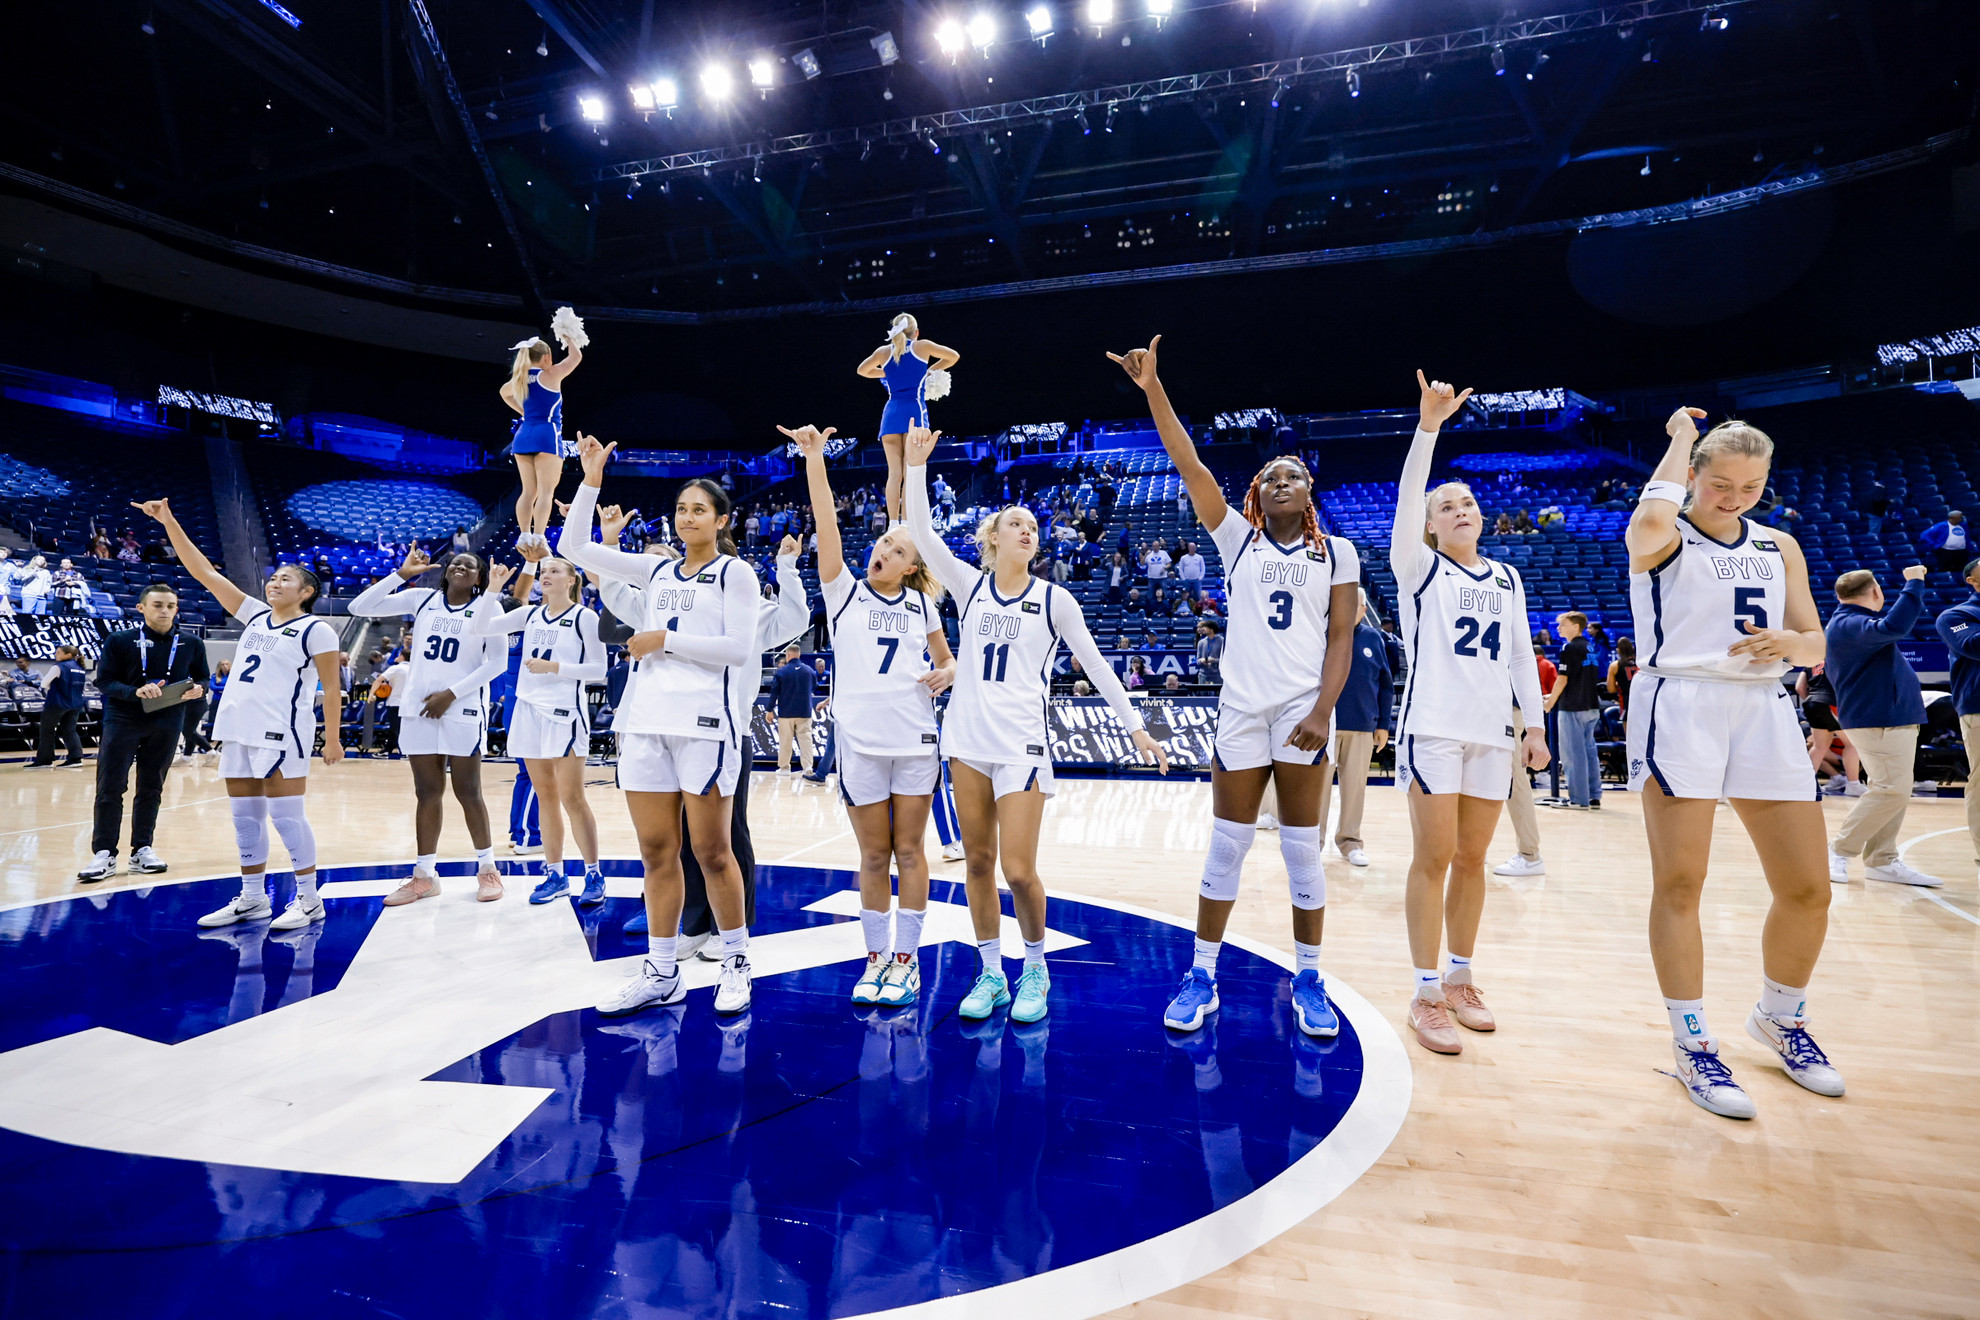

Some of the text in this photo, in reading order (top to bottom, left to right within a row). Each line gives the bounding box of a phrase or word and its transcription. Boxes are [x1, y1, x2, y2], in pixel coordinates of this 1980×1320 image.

[1261, 561, 1308, 586] BYU
[1711, 557, 1773, 580] BYU
[657, 589, 696, 611] BYU
[1268, 590, 1293, 630] 3
[1460, 587, 1502, 614] BYU
[1735, 587, 1768, 635] 5
[431, 617, 463, 634] BYU
[869, 610, 909, 633] BYU
[979, 613, 1021, 639] BYU
[244, 632, 279, 652] BYU
[424, 635, 460, 663] 30
[532, 629, 558, 645] BYU
[1454, 616, 1501, 661] 24
[239, 654, 261, 683] 2
[877, 637, 899, 674] 7
[983, 642, 1009, 682] 11
[1140, 699, 1166, 707] vivint
